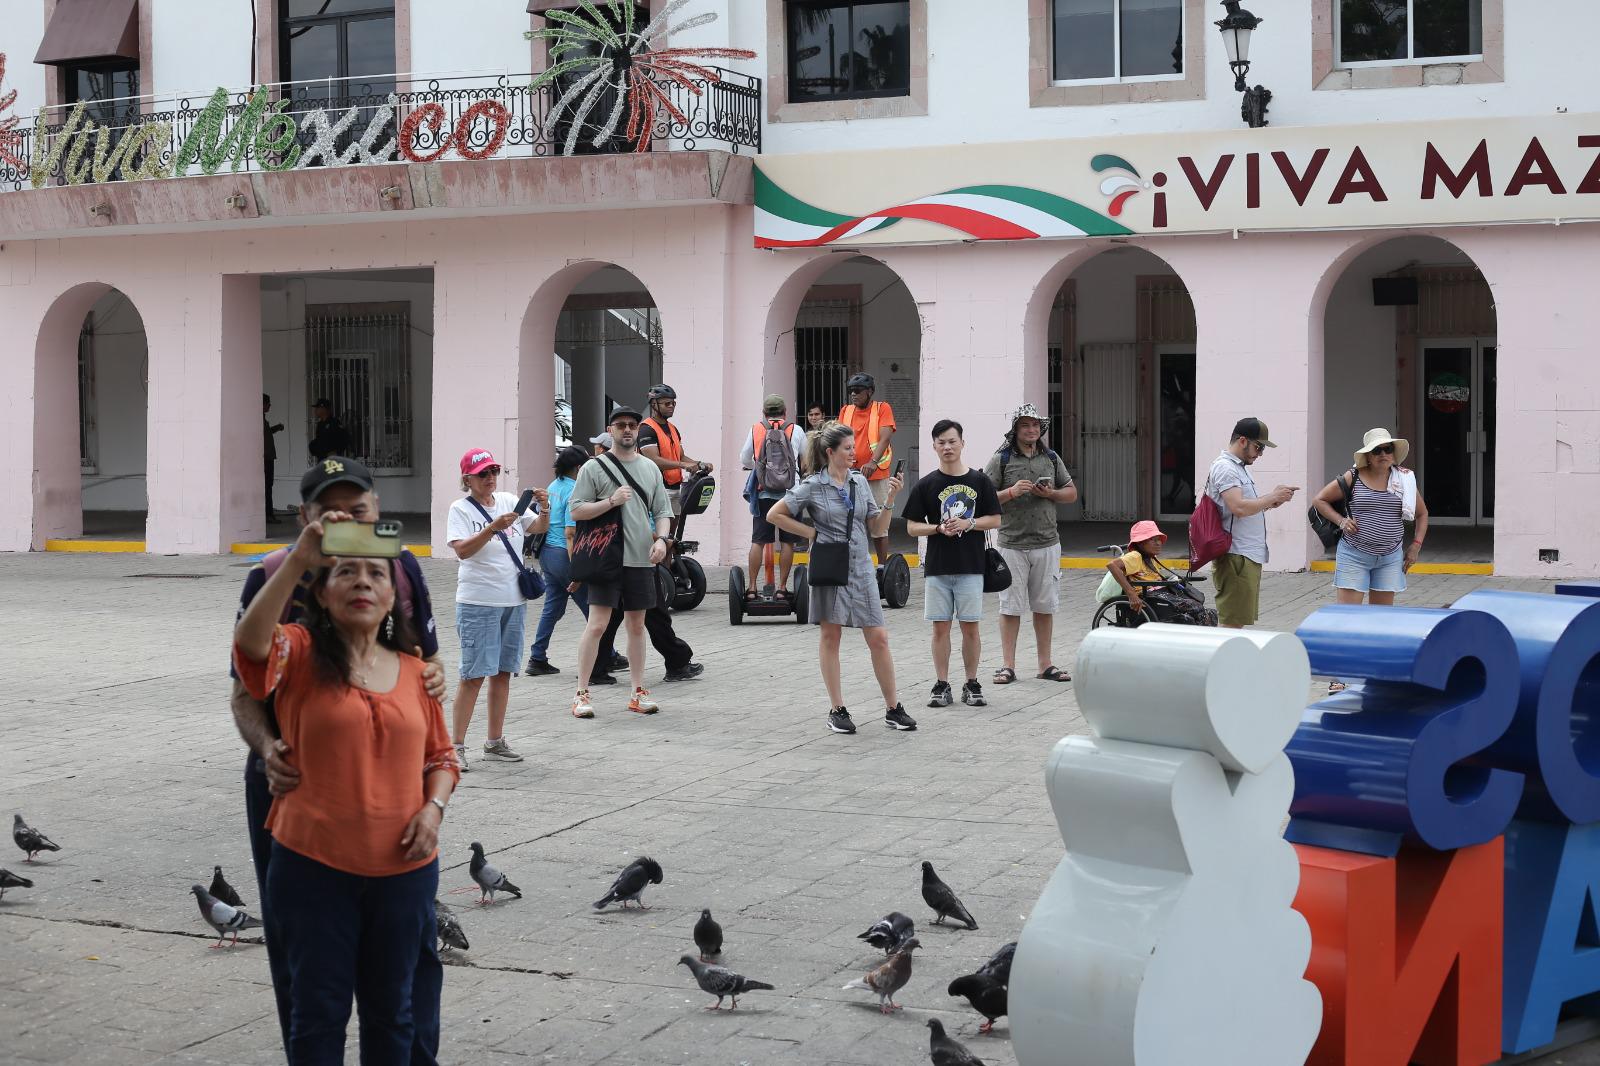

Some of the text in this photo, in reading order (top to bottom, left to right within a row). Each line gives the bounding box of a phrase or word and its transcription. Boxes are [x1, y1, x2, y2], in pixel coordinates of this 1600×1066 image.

[1152, 135, 1600, 229] ¡VIVA MAZ
[323, 459, 345, 475] LA
